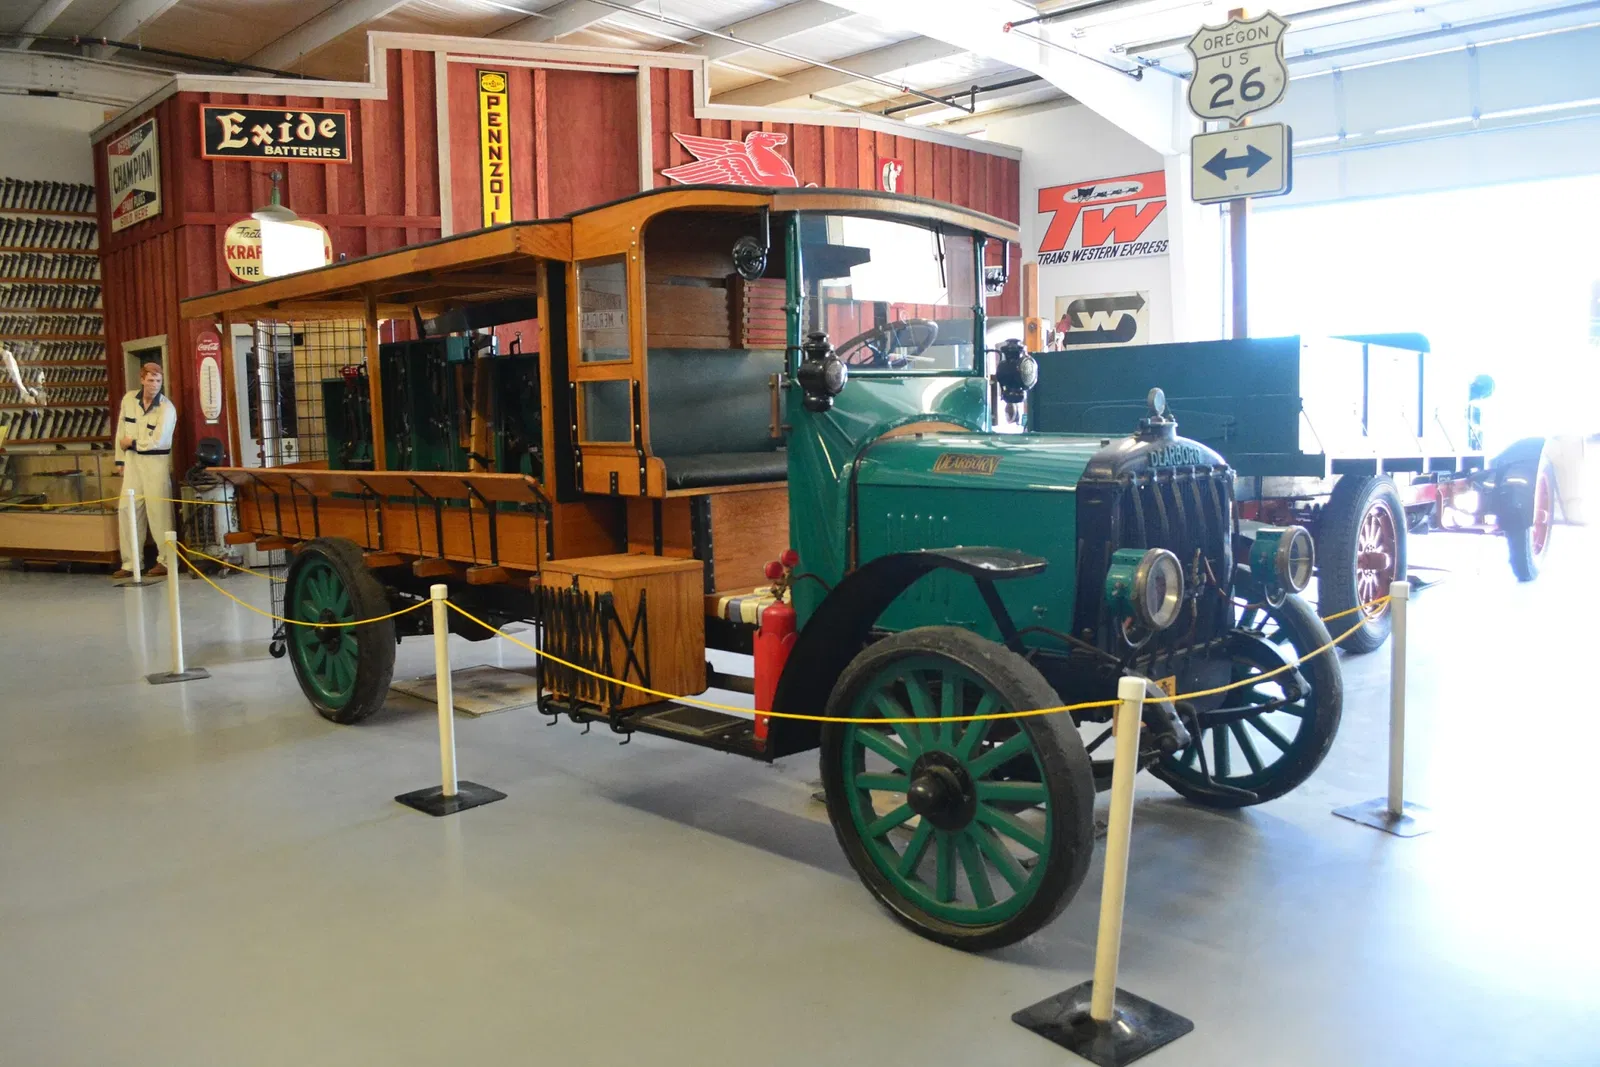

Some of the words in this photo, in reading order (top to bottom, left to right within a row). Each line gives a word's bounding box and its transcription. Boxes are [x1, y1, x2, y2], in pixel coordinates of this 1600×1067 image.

[1203, 25, 1269, 51] OREGON
[1208, 66, 1265, 110] 26
[216, 111, 337, 151] Exide
[264, 145, 341, 158] BATTERIES
[486, 95, 506, 224] PENNZOIL
[113, 148, 152, 194] CHAMPION
[1037, 169, 1168, 254] TW
[1038, 251, 1070, 265] TRANS
[1071, 245, 1121, 262] WESTERN
[1120, 239, 1170, 257] EXPRESS
[235, 266, 260, 276] TIRE
[934, 453, 999, 473] DEARBORN
[1148, 445, 1201, 467] DEARBORN
